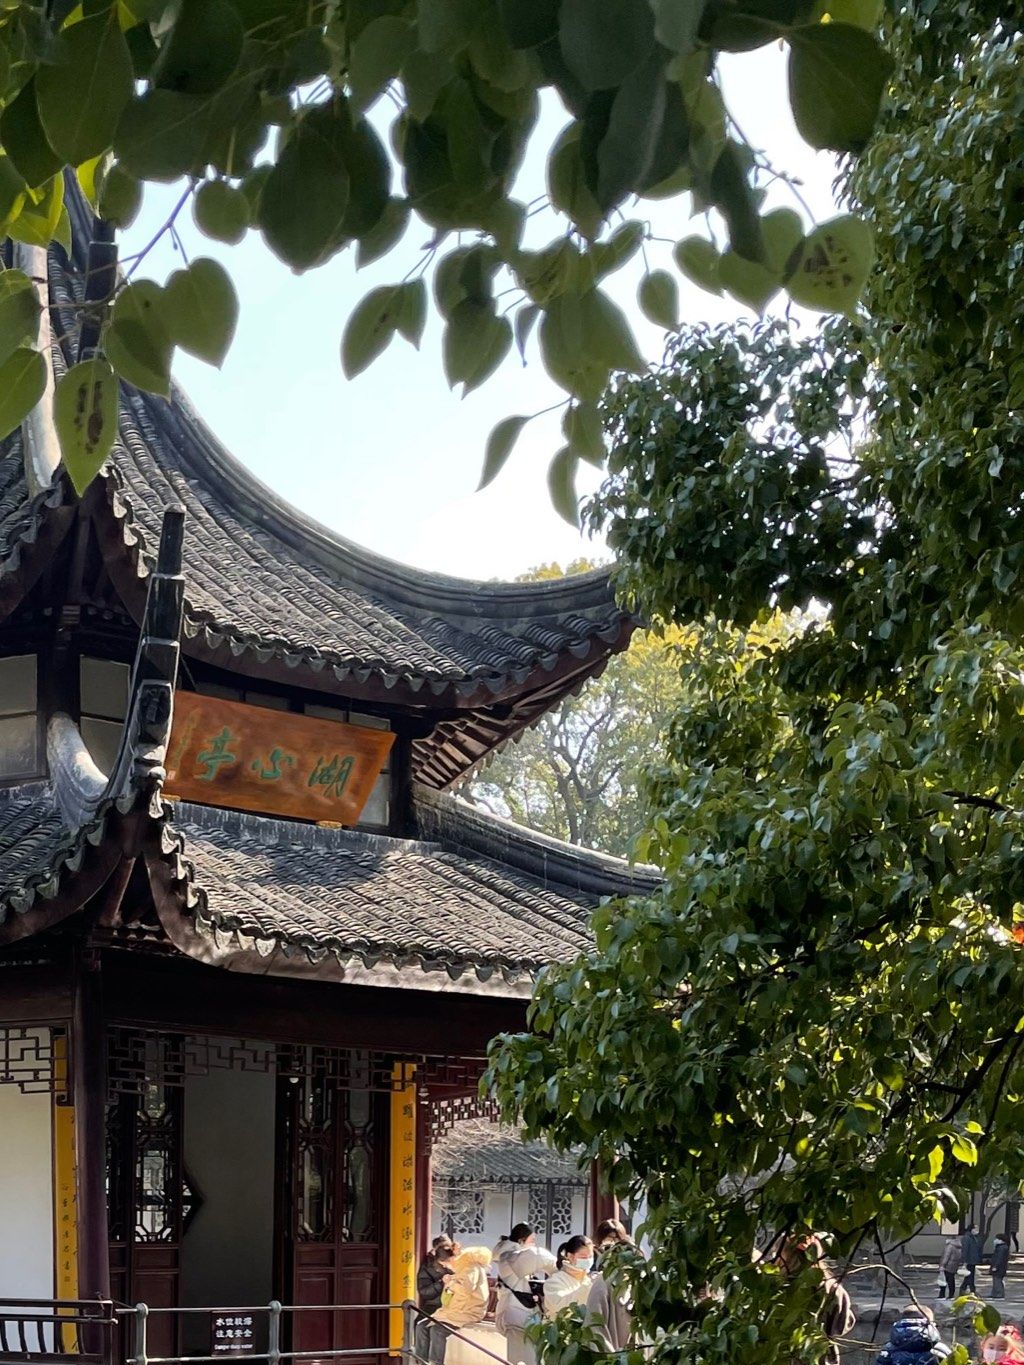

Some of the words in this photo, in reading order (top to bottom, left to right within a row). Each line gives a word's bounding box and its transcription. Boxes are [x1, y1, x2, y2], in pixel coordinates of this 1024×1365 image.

[193, 725, 355, 798] 湖心亭
[216, 1329, 253, 1338] 注意安全
